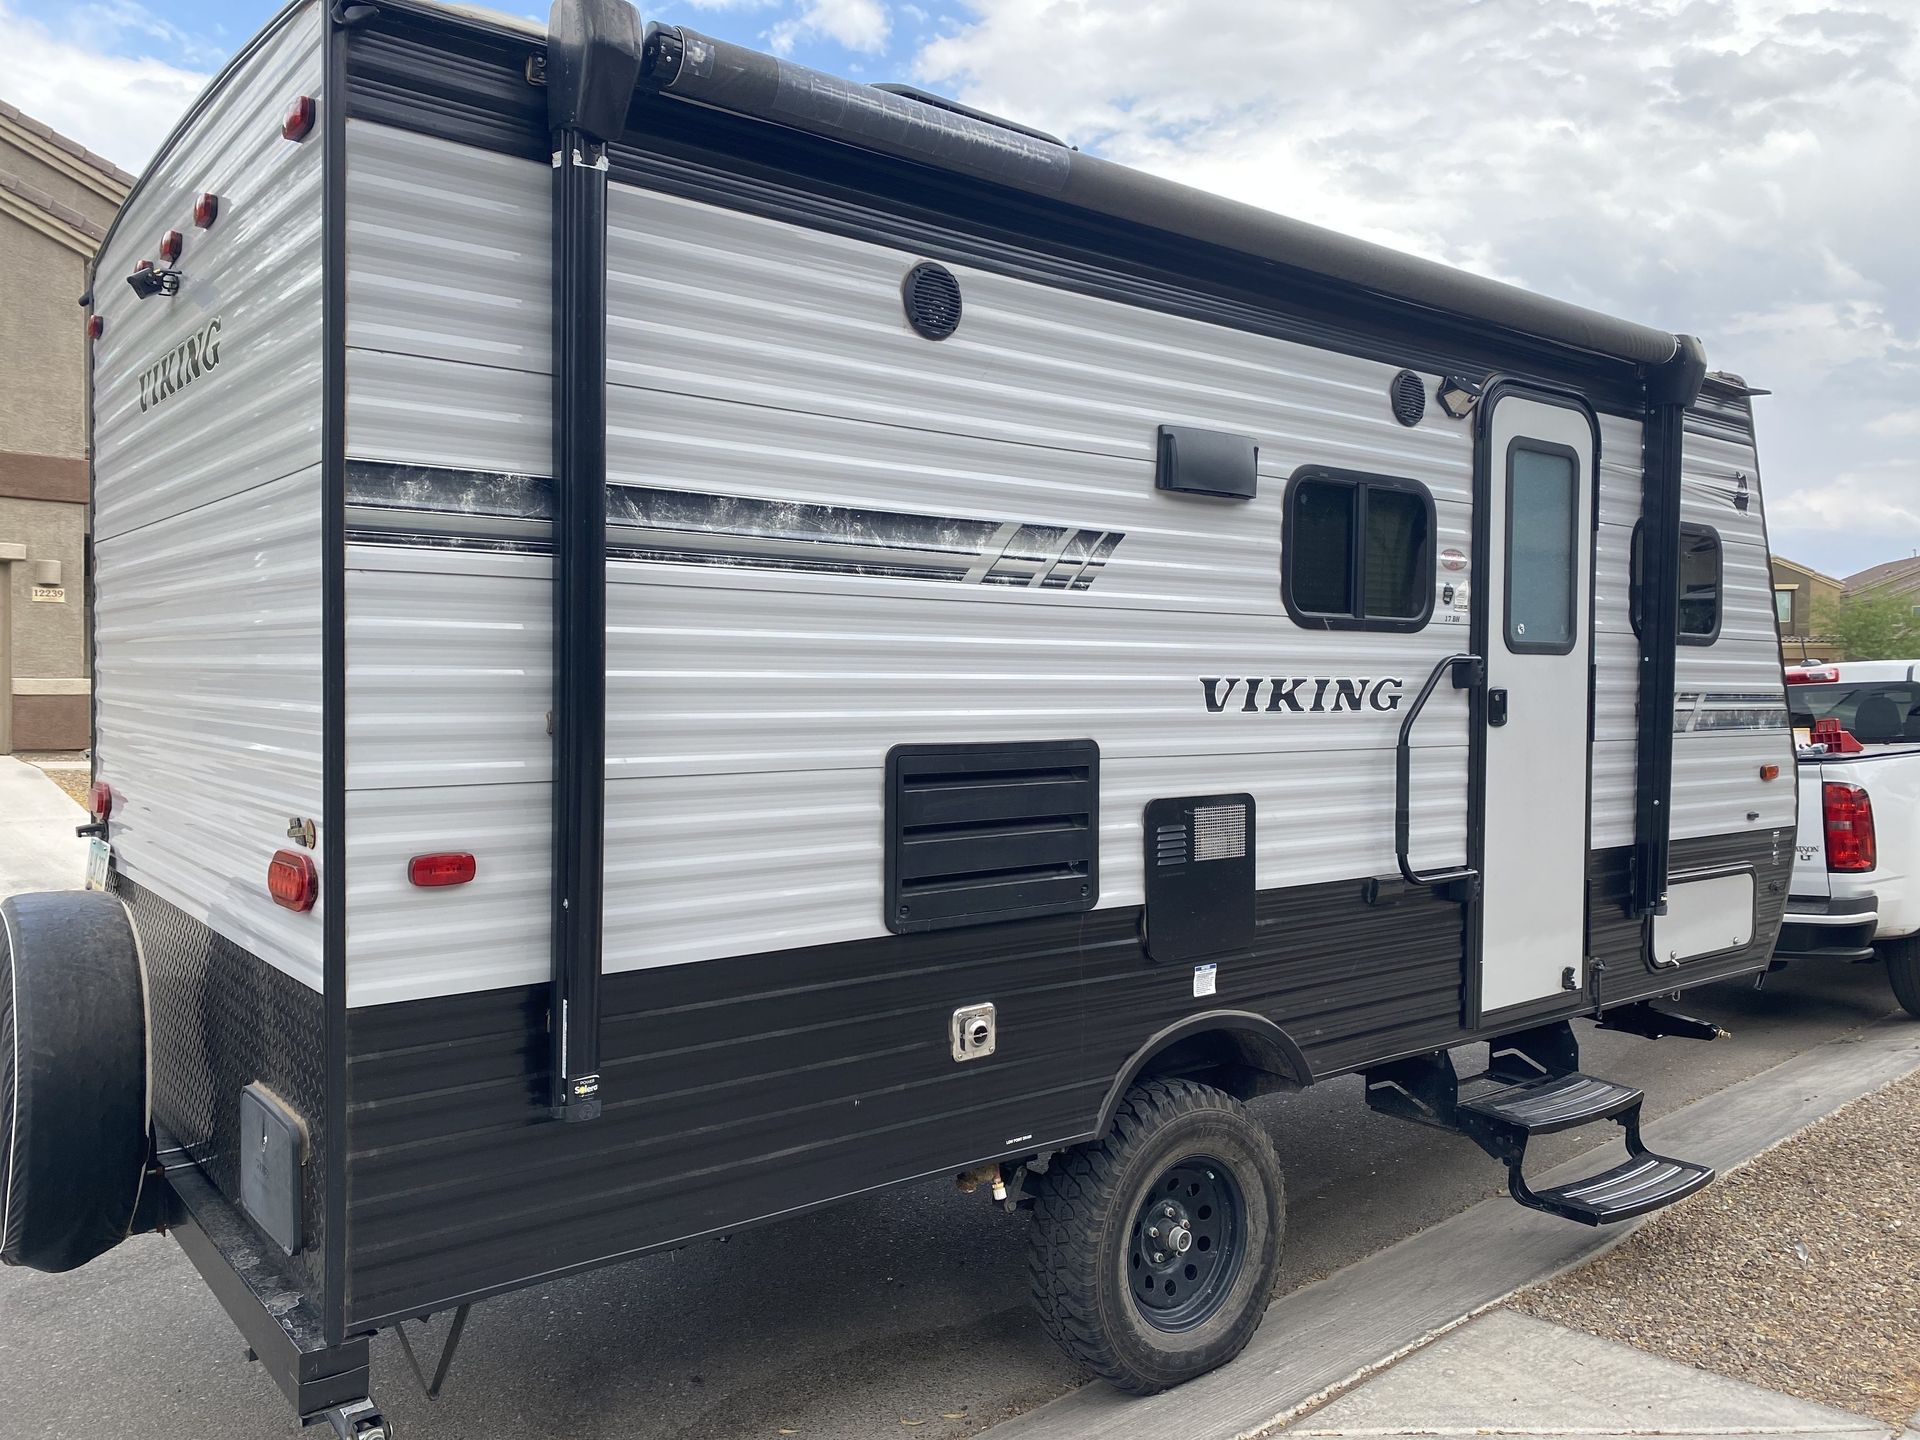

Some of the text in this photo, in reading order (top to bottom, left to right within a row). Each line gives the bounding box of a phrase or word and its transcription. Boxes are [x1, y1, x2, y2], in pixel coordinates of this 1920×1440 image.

[138, 317, 221, 413] VIKING
[34, 589, 64, 598] 12239
[1199, 676, 1403, 713] VIKING
[574, 1084, 599, 1094] Solera
